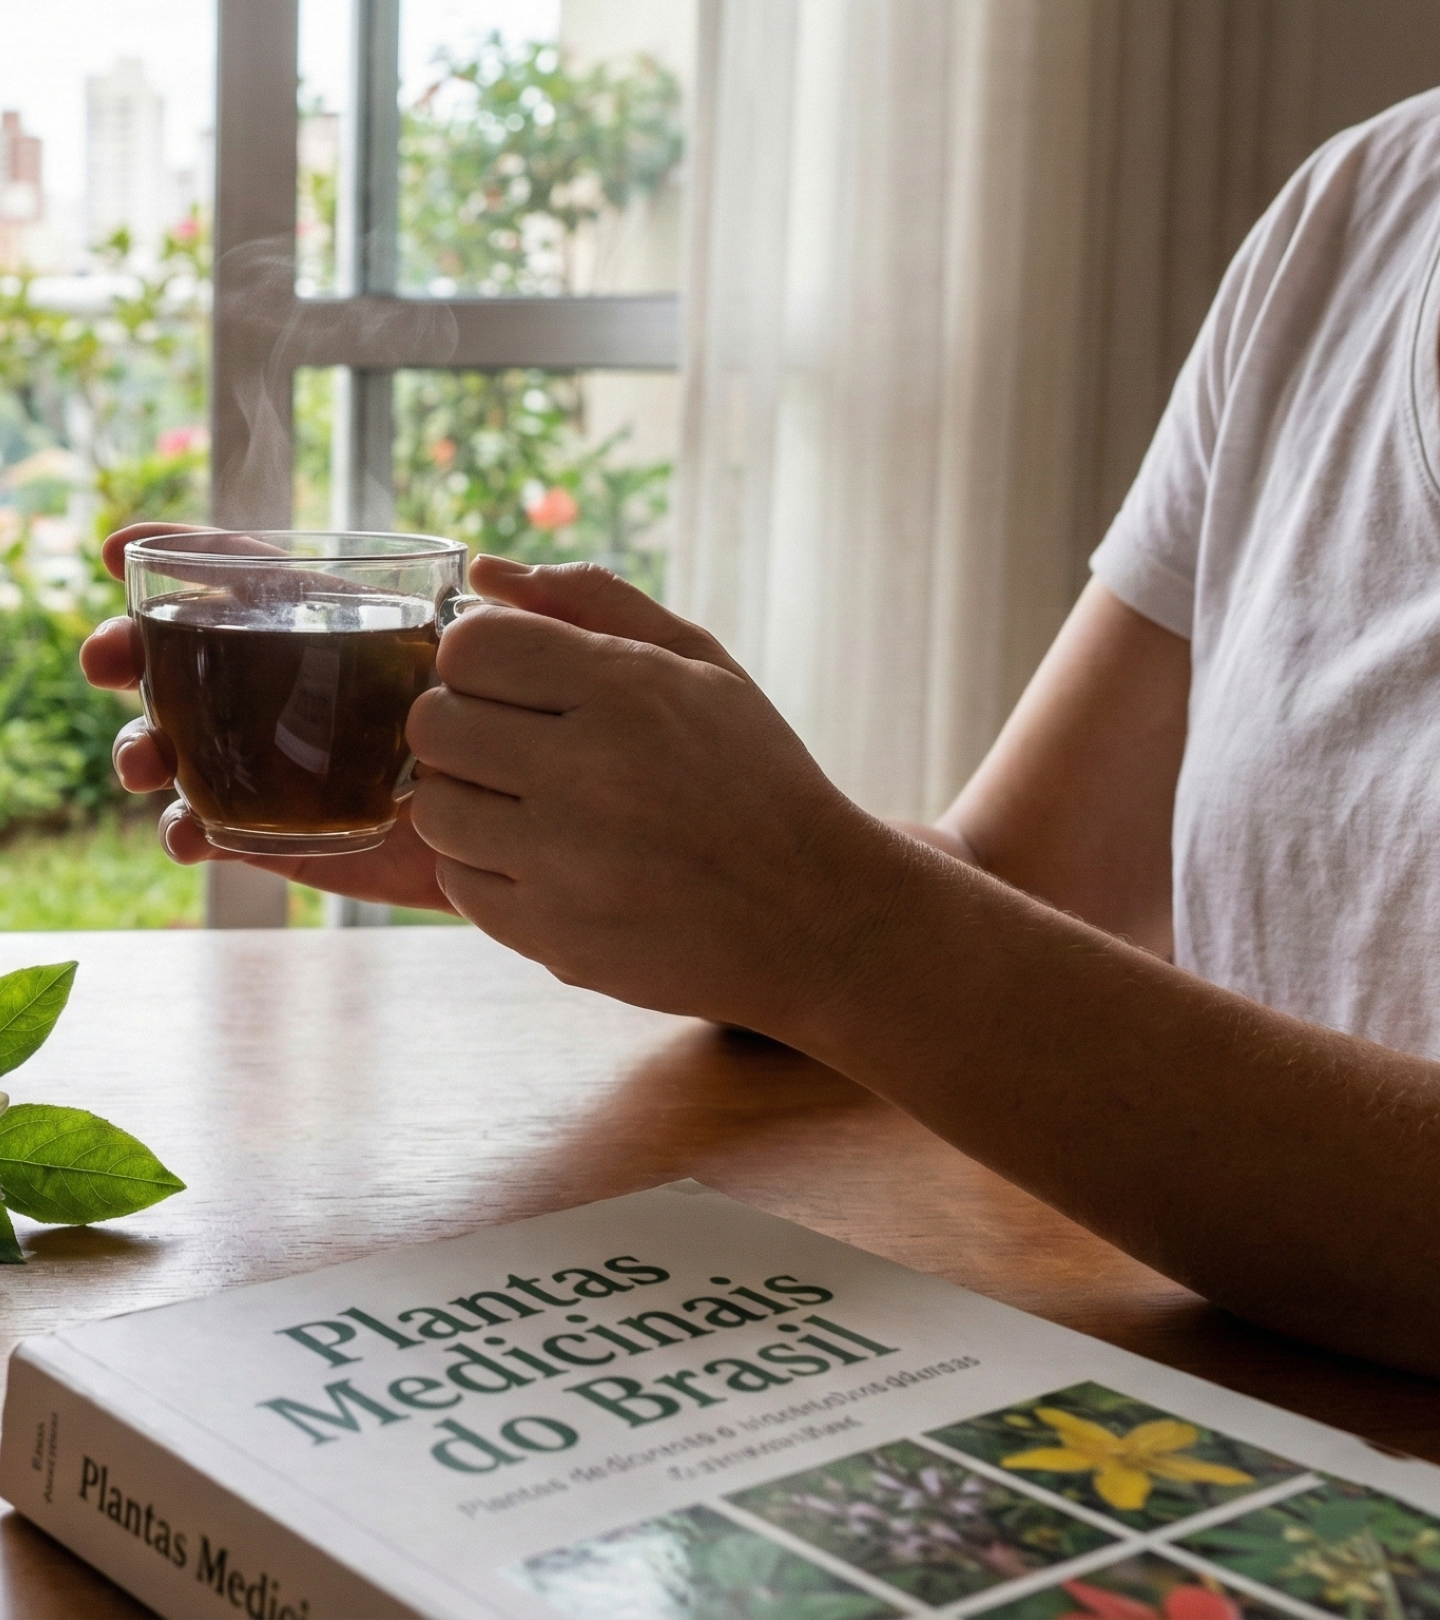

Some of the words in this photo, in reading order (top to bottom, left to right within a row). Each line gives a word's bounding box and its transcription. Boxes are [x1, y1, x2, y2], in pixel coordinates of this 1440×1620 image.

[254, 1273, 835, 1446] Medicinais
[273, 1255, 671, 1368] Plantas
[429, 1416, 580, 1474] do
[564, 1314, 901, 1428] Brasil
[78, 1454, 188, 1569] Plantas
